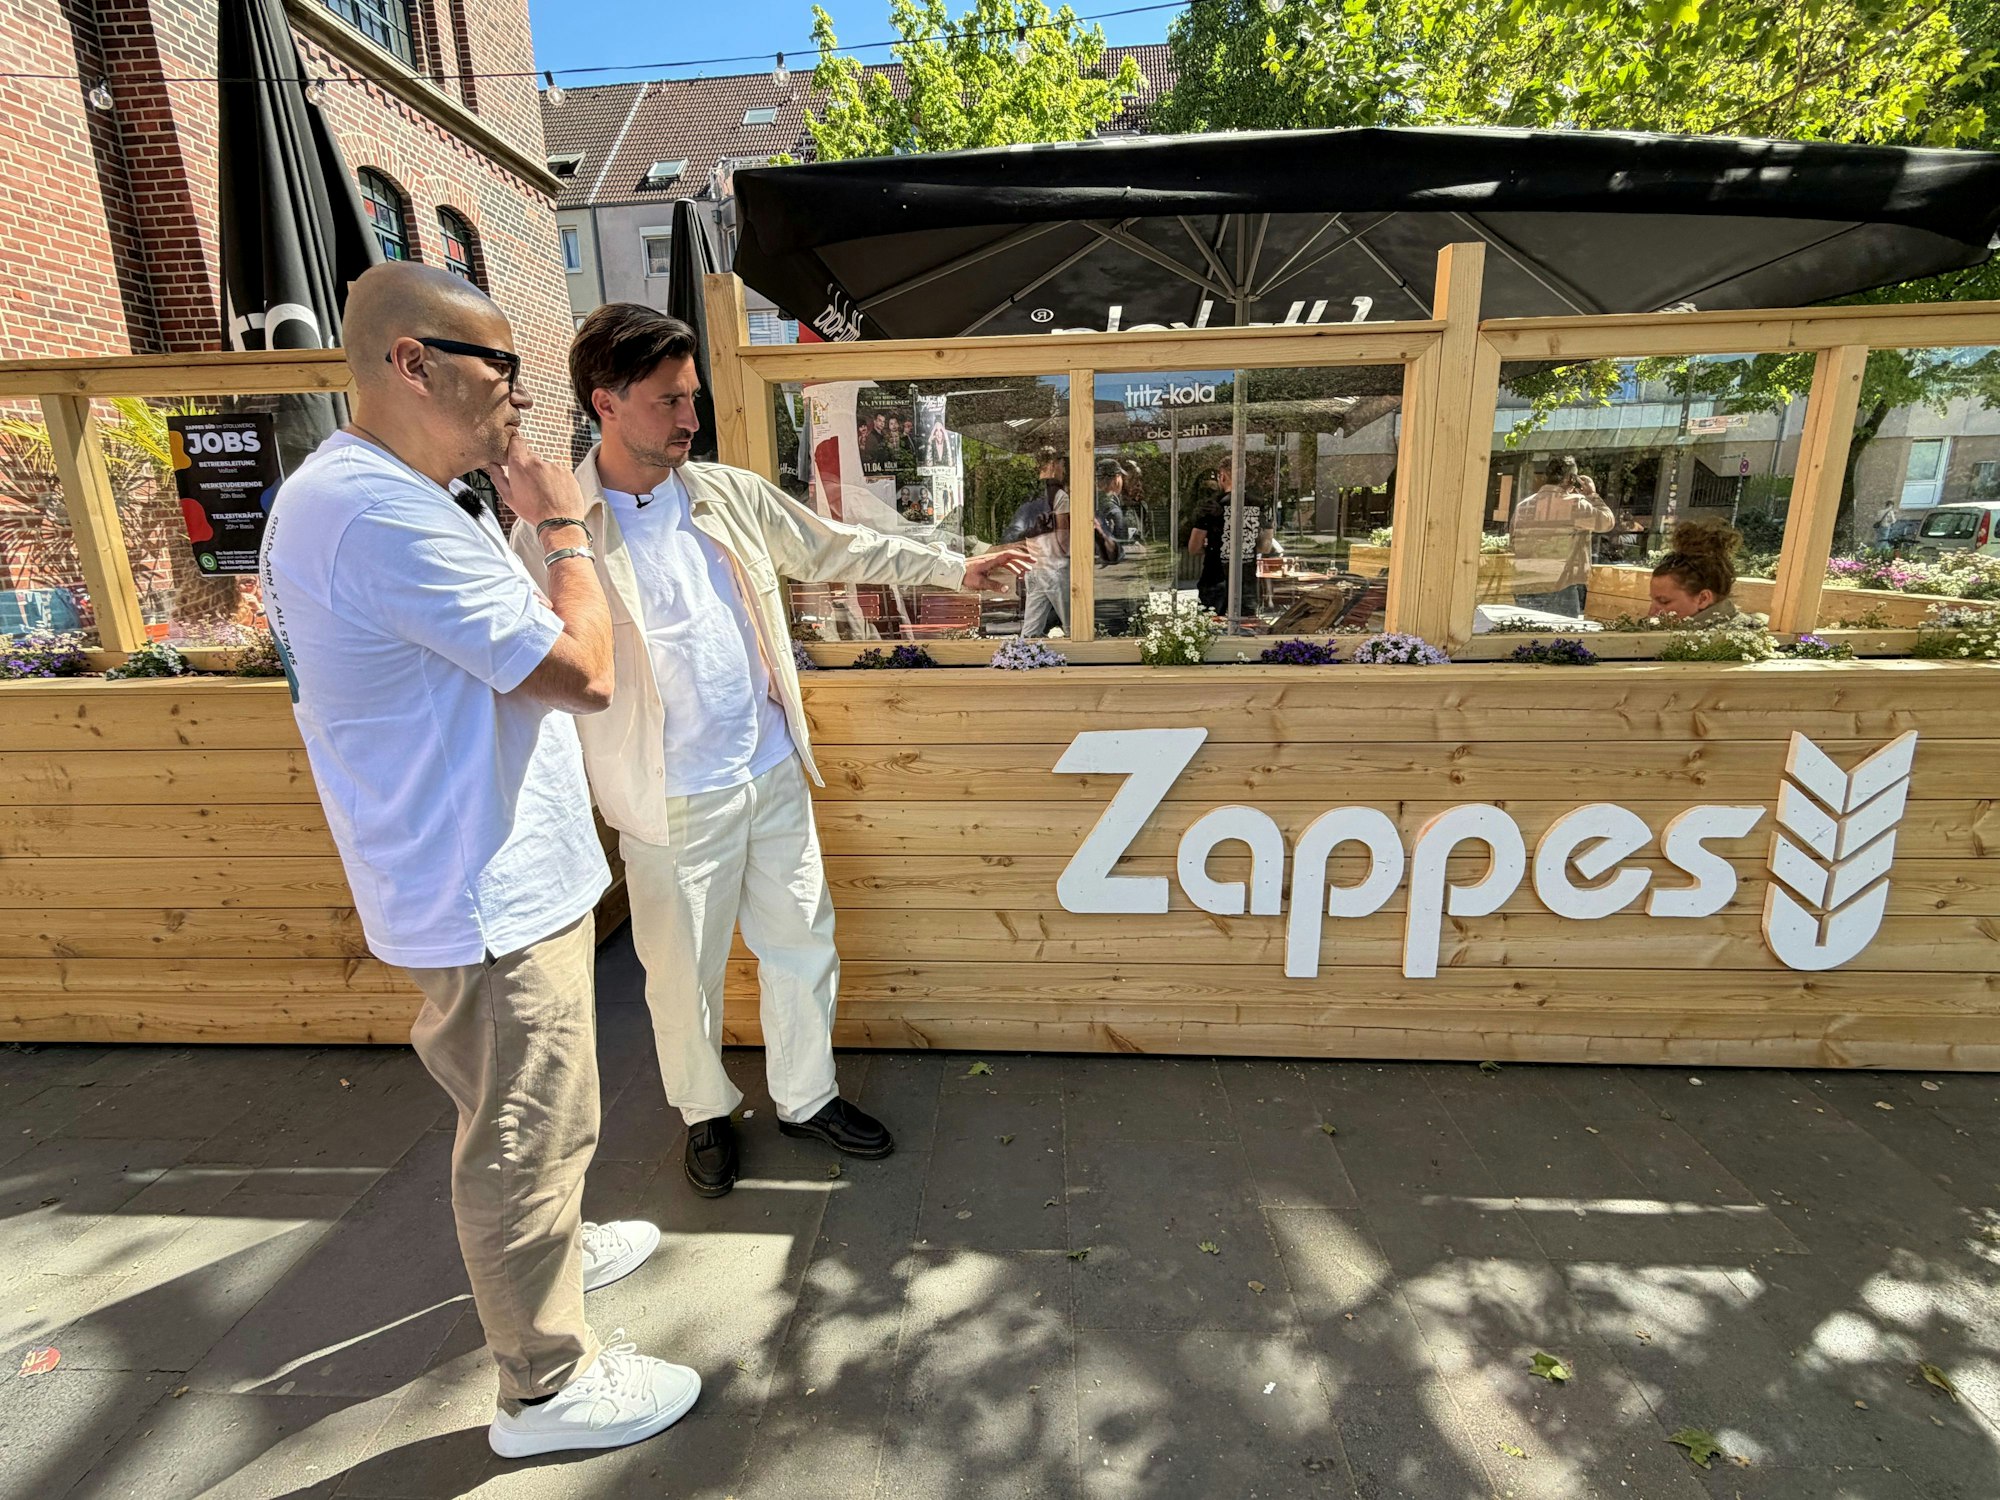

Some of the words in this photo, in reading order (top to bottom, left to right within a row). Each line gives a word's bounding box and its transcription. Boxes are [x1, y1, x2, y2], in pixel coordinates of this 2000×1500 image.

[187, 430, 261, 455] JOBS
[198, 459, 256, 468] BETRIEBSLEITUNG
[199, 481, 264, 489] WERKSTUDIERENDE
[211, 511, 264, 520] TEILZEITKRÄFTE
[275, 605, 286, 628] ALL
[279, 629, 298, 666] STARS
[1051, 726, 1768, 979] Zappes
